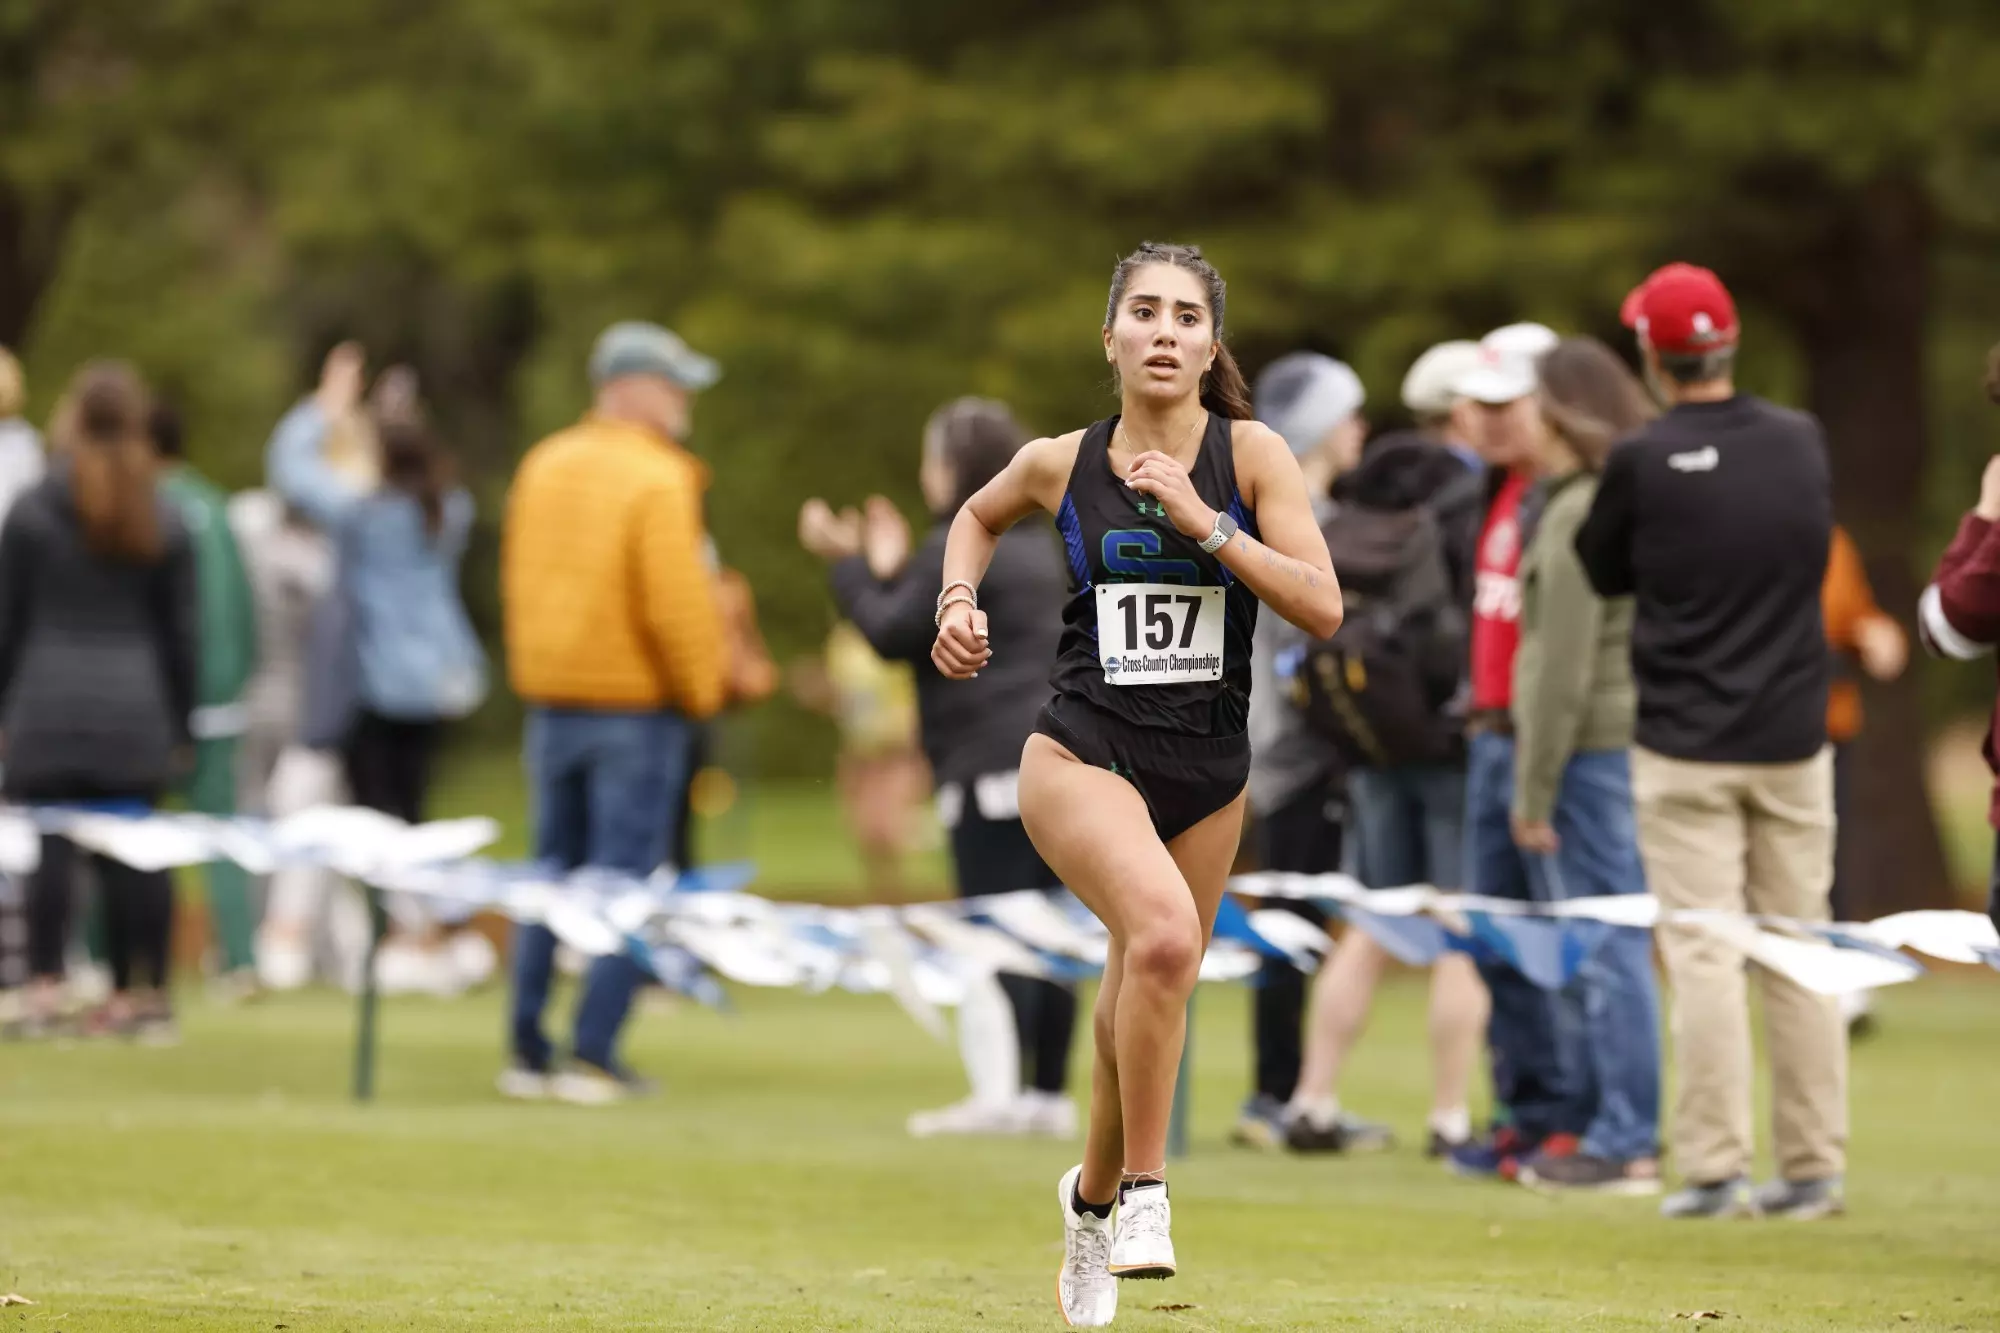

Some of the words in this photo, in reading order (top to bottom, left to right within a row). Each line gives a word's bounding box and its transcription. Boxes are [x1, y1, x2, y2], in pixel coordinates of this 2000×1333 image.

[1117, 594, 1202, 650] 157
[1122, 655, 1168, 674] Cross-Country
[1169, 653, 1220, 674] Championships
